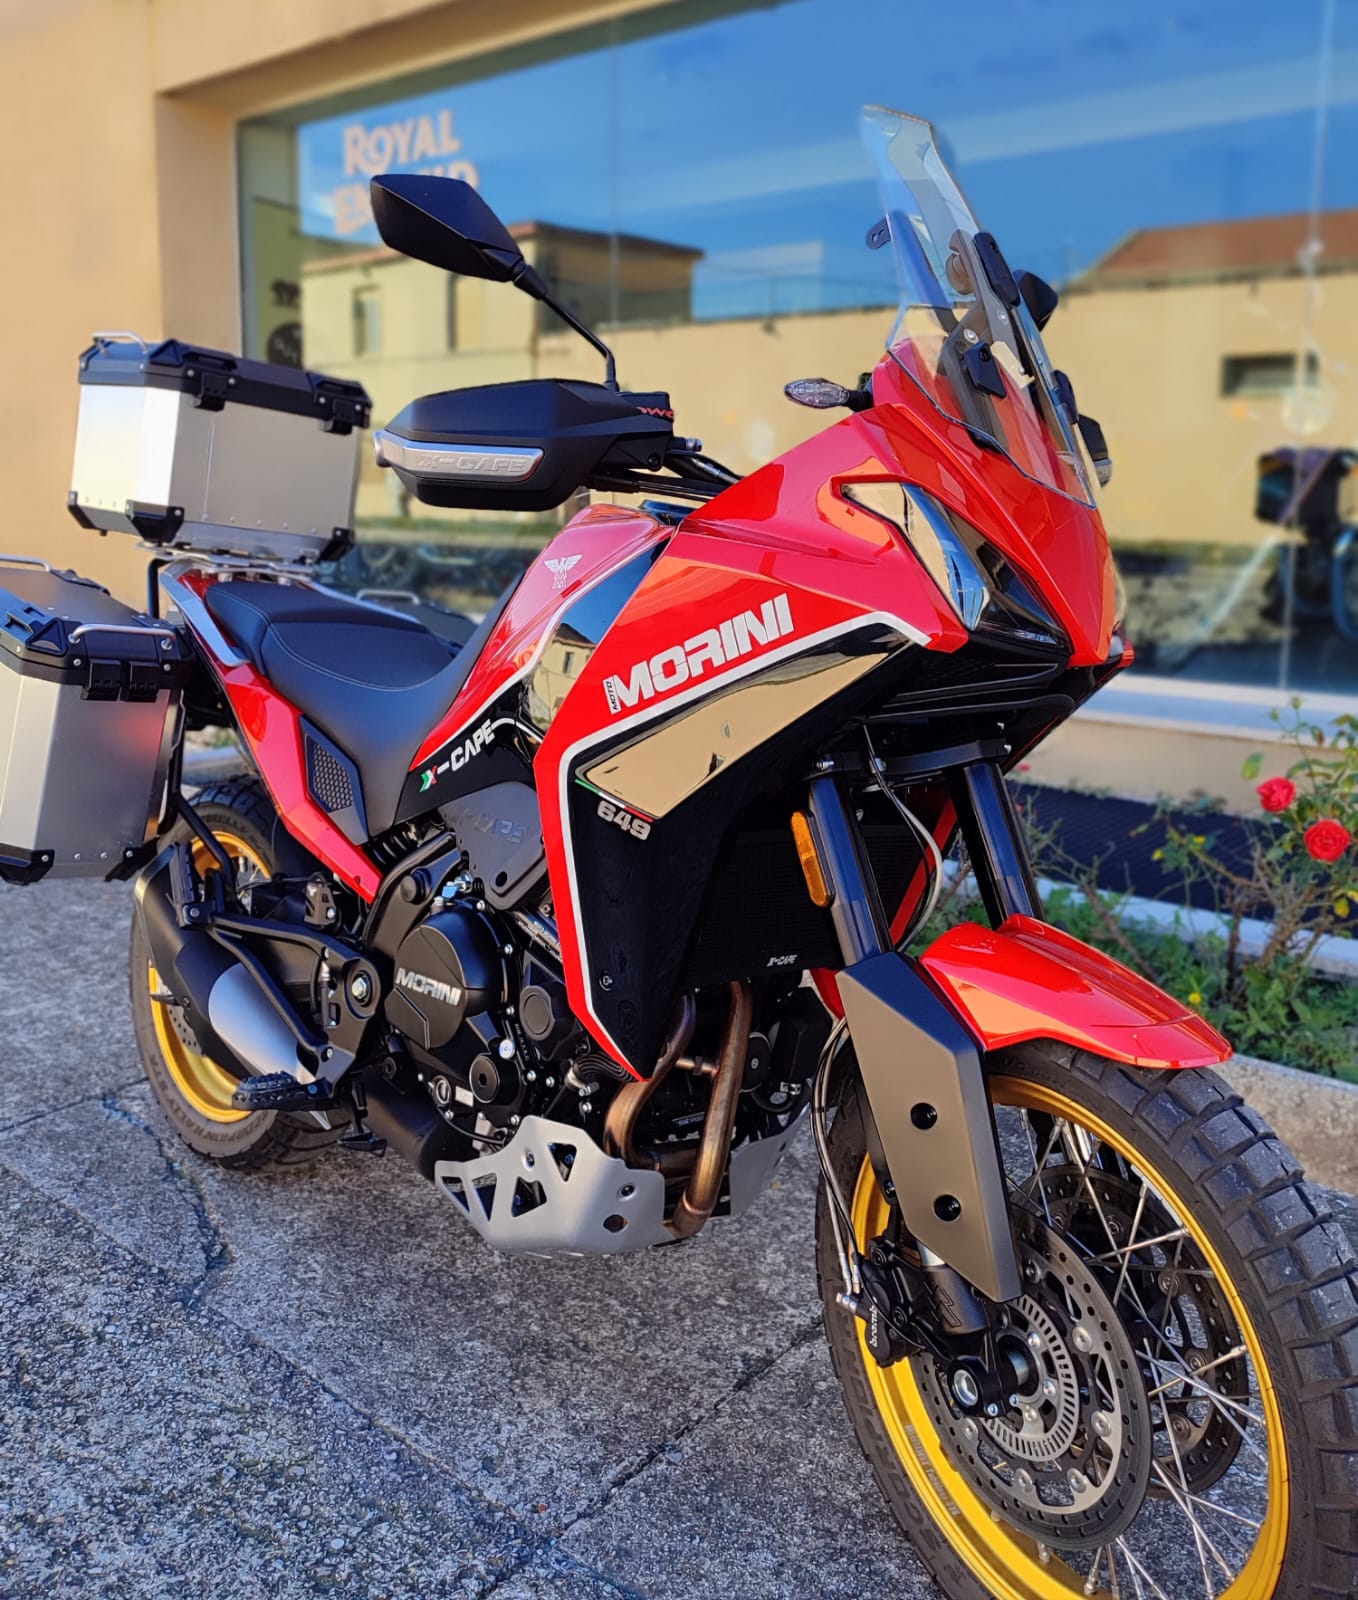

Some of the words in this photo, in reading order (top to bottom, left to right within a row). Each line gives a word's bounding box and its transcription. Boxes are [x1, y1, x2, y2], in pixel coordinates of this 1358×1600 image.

[343, 109, 461, 178] ROYAL
[417, 453, 527, 473] X-CAPE
[605, 680, 619, 711] MOTO
[613, 593, 795, 708] MORINI
[419, 719, 496, 793] X-CAPE
[597, 800, 651, 840] 649
[395, 967, 462, 1006] MORINI
[841, 1344, 942, 1554] SCORPION
